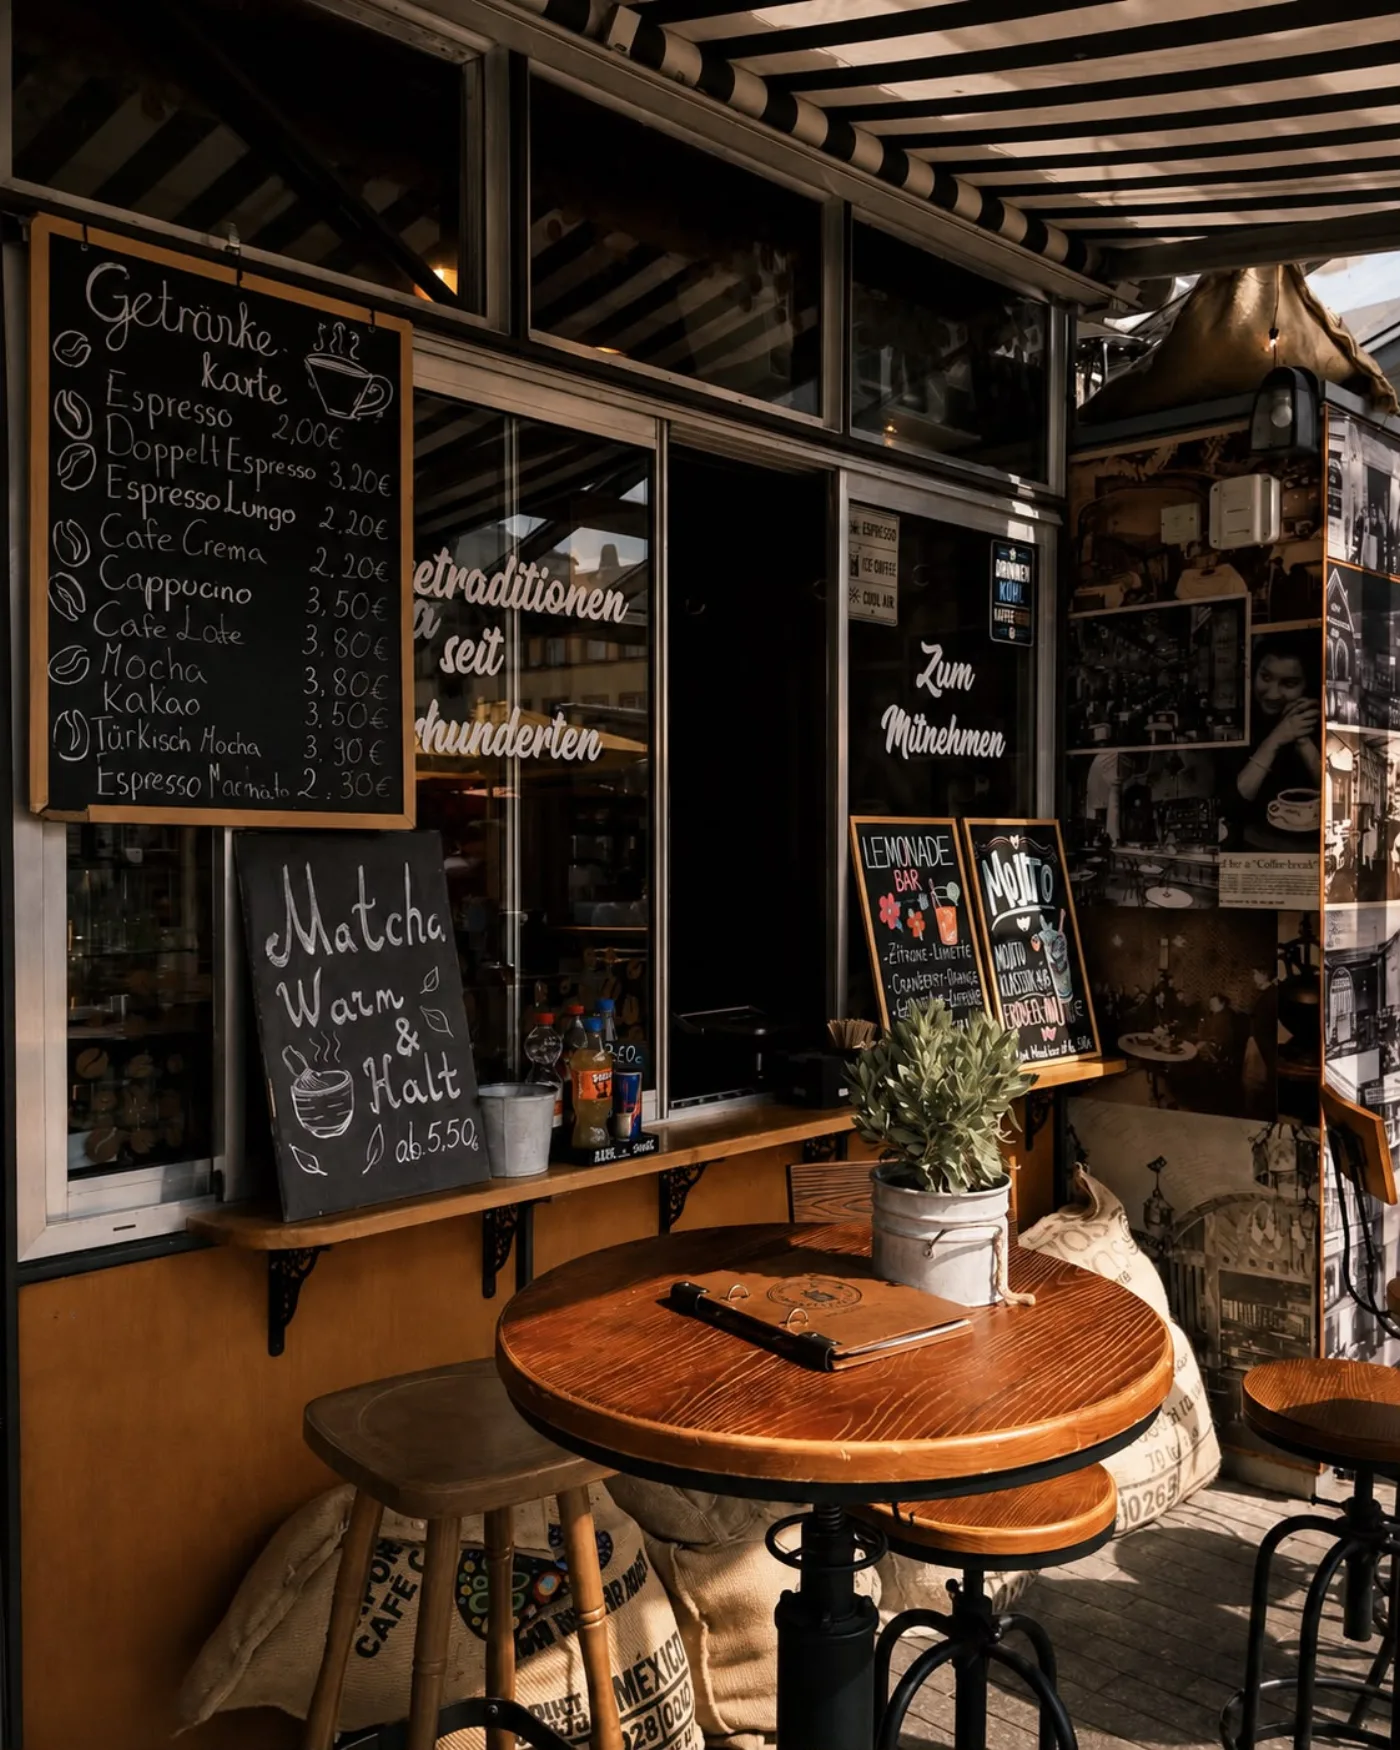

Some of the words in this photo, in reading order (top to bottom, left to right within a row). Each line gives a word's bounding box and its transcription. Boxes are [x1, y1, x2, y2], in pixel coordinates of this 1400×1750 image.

[106, 369, 233, 429] Espresso
[106, 412, 220, 480] Doppelt
[227, 436, 317, 492] Espresso
[182, 518, 268, 564] Crema
[862, 521, 897, 542] ESPRESSO
[99, 554, 253, 612] Cappucino
[413, 546, 630, 623] etraditionen
[93, 601, 168, 638] Cafe
[439, 625, 505, 677] seit
[915, 640, 976, 699] Zum
[103, 681, 201, 717] Kakao
[880, 704, 1007, 760] Mitnehmen
[97, 764, 201, 801] Espresso
[862, 835, 954, 869] LEMONADE
[893, 867, 924, 893] BAR
[982, 849, 1054, 917] MOJITO
[266, 861, 447, 968] Matcha
[276, 966, 404, 1028] Warm
[395, 1016, 421, 1057] &
[362, 1050, 462, 1115] Halt
[355, 1573, 418, 1659] CAFÉ
[611, 1630, 687, 1713] MÉXICO
